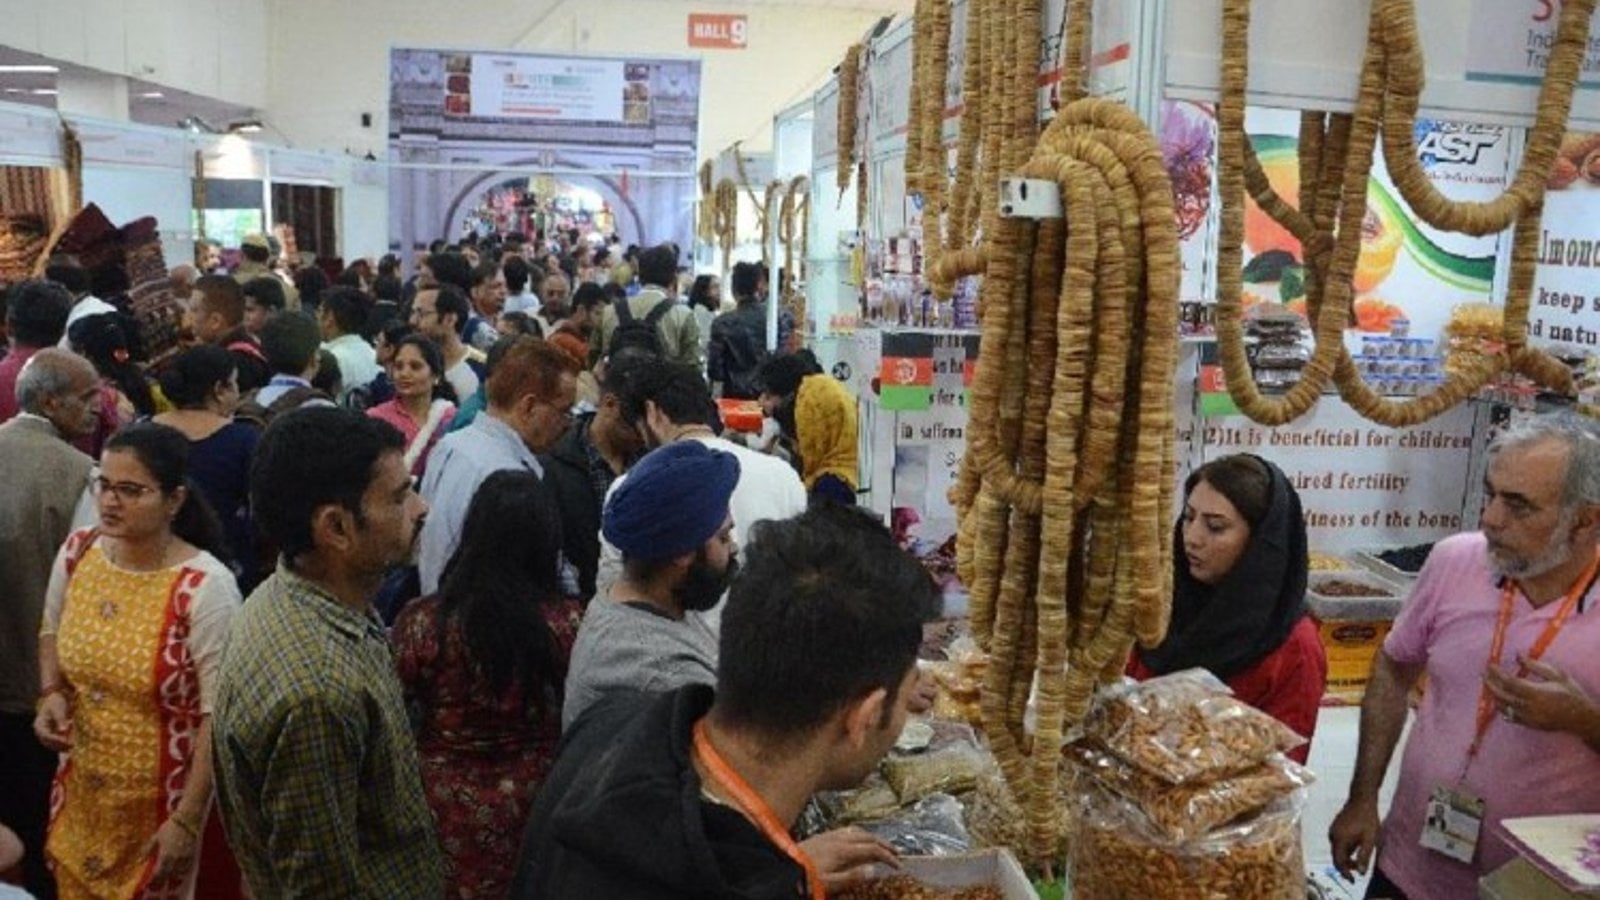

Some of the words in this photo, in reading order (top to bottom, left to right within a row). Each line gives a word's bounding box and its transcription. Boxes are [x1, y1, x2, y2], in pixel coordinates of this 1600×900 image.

[694, 22, 729, 39] HALL
[730, 19, 747, 44] 9
[1538, 286, 1585, 314] keep
[1248, 427, 1263, 446] is
[1270, 428, 1359, 447] beneficial
[1366, 428, 1393, 447] for
[1398, 430, 1473, 449] children
[1339, 470, 1409, 495] fertility
[1361, 508, 1381, 528] of
[1385, 510, 1411, 528] the
